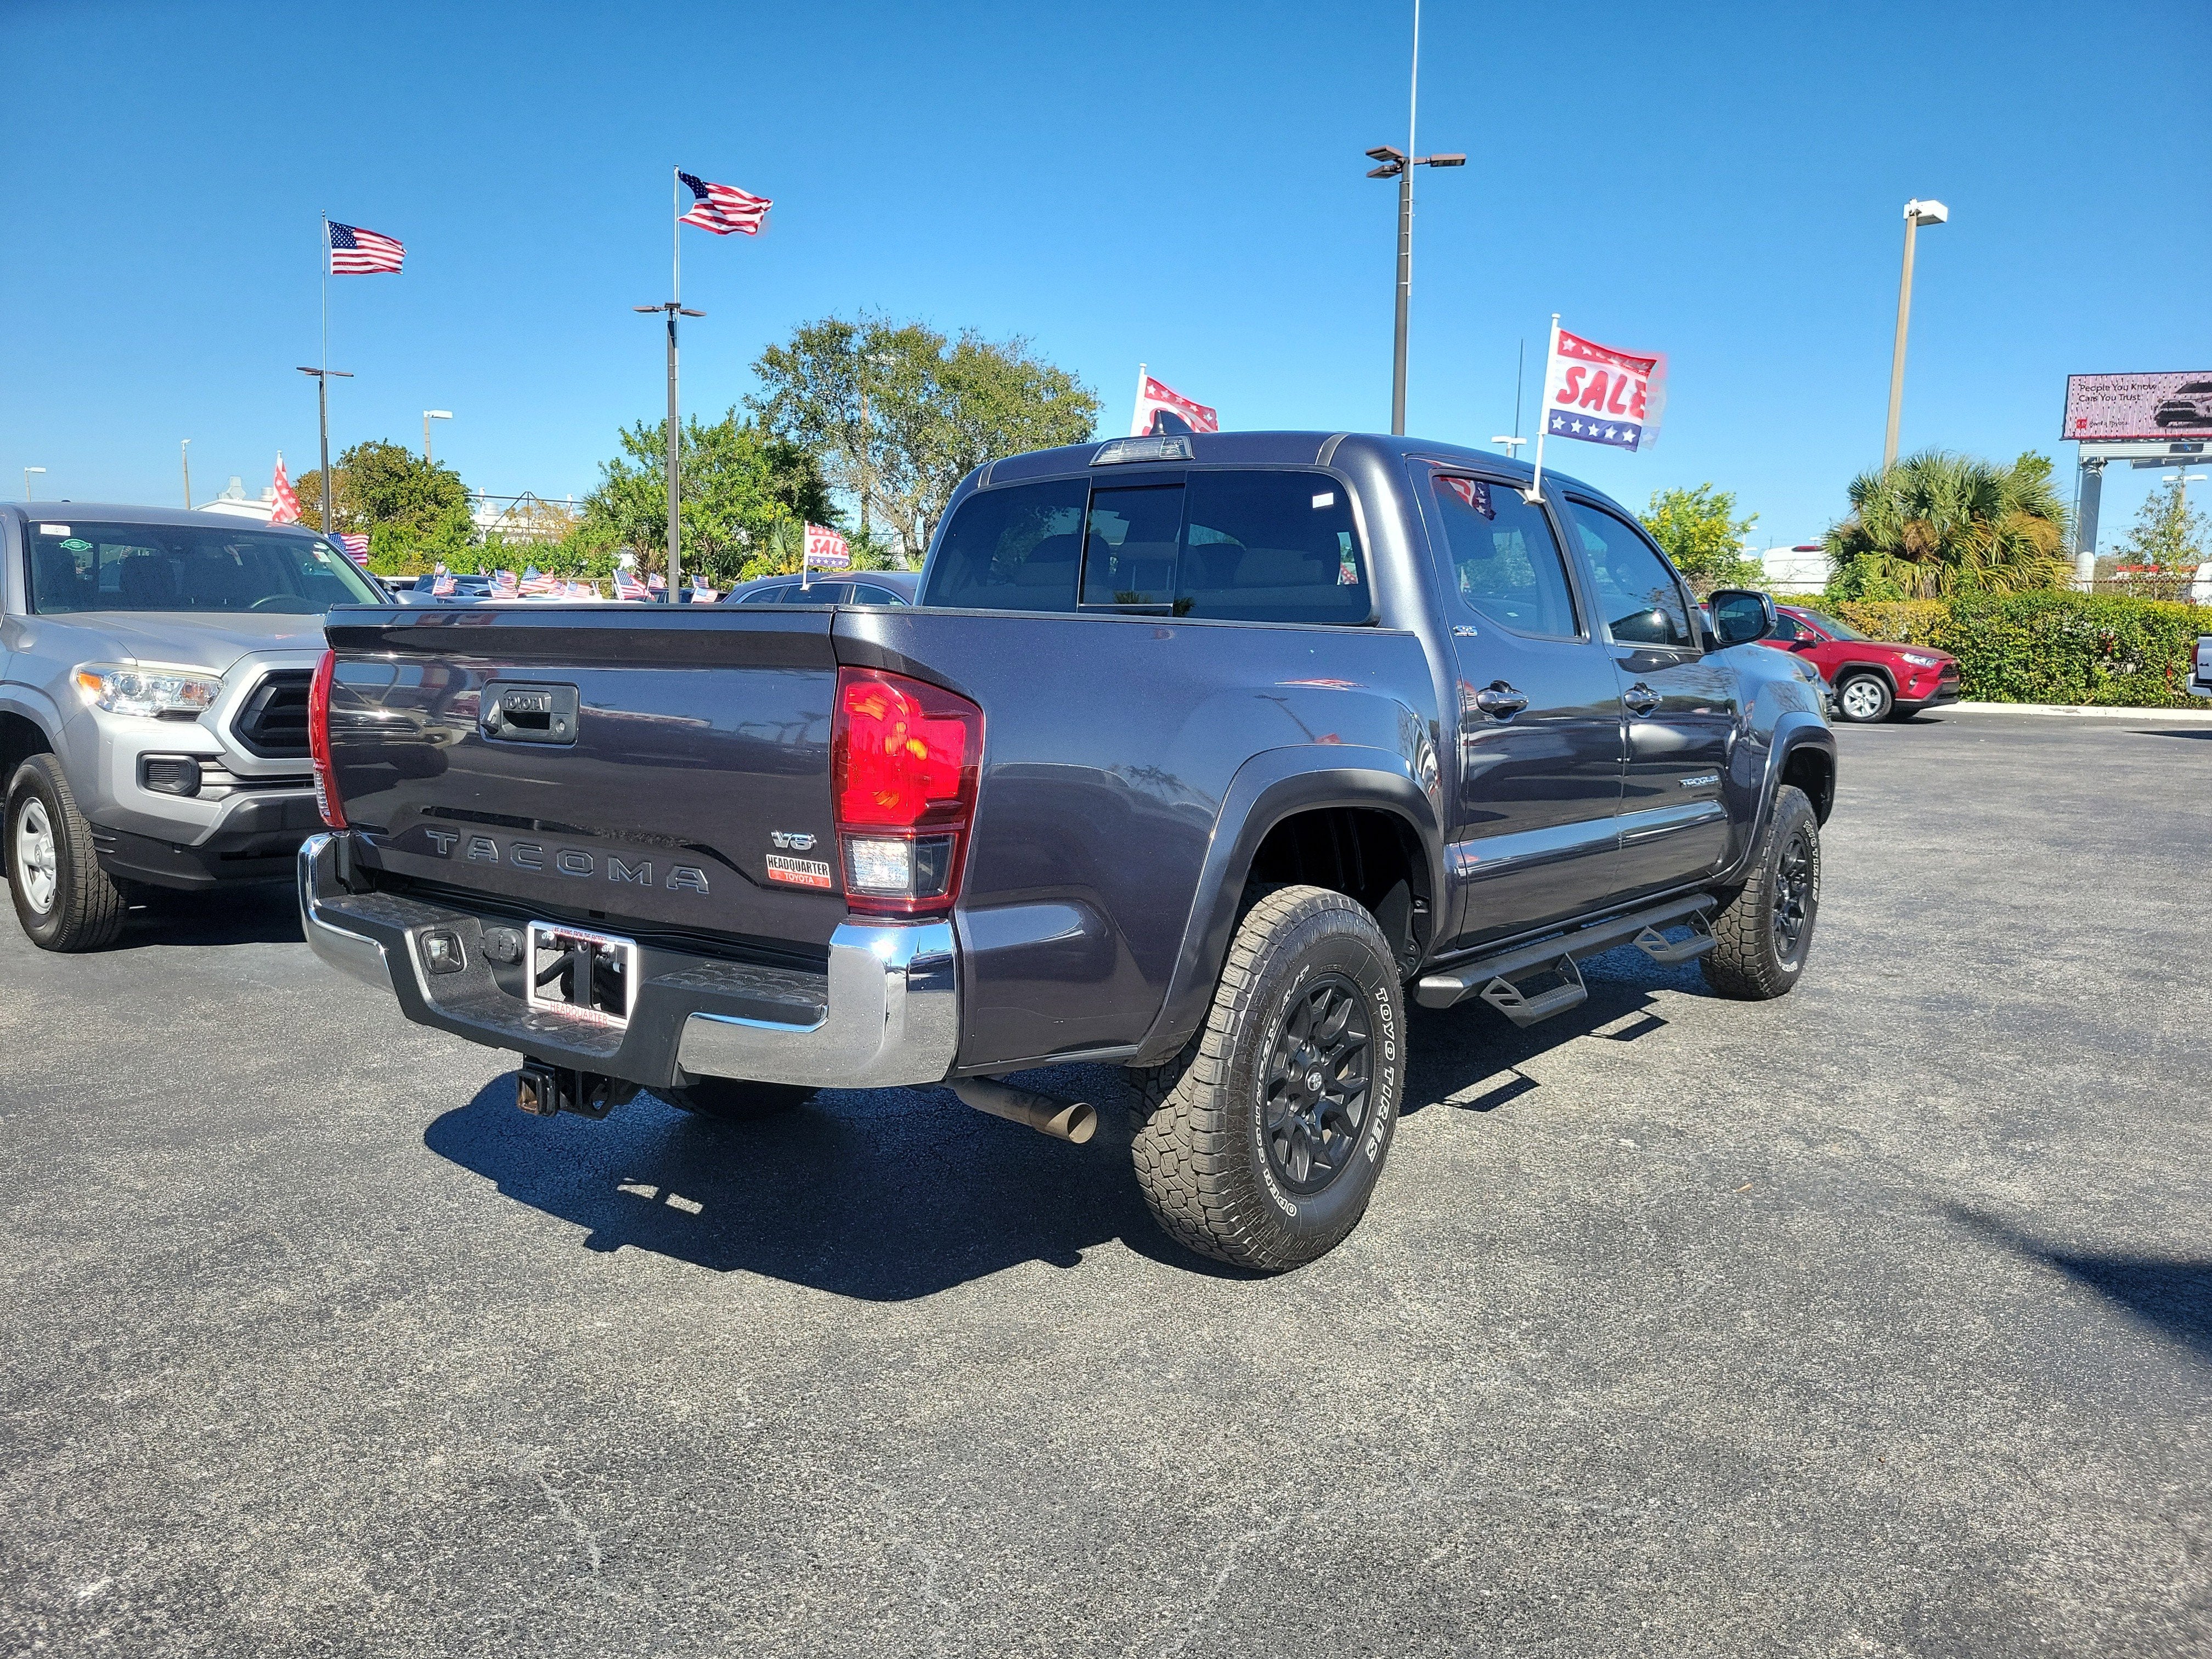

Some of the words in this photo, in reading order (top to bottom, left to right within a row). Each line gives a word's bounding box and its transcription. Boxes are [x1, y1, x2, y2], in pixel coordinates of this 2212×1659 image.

[1556, 366, 1647, 420] SALE
[2079, 384, 2111, 393] People
[810, 538, 849, 556] SALE
[504, 696, 544, 710] TOYOTA
[771, 831, 816, 850] V6
[426, 830, 710, 895] TACOMA
[768, 856, 828, 876] HEADQUARTER
[785, 873, 815, 884] TOYOTA
[550, 1002, 608, 1025] HEADQUARTER
[1375, 988, 1396, 1062] TOYO
[1365, 1066, 1395, 1163] TIRES
[1263, 1168, 1297, 1217] OPEN
